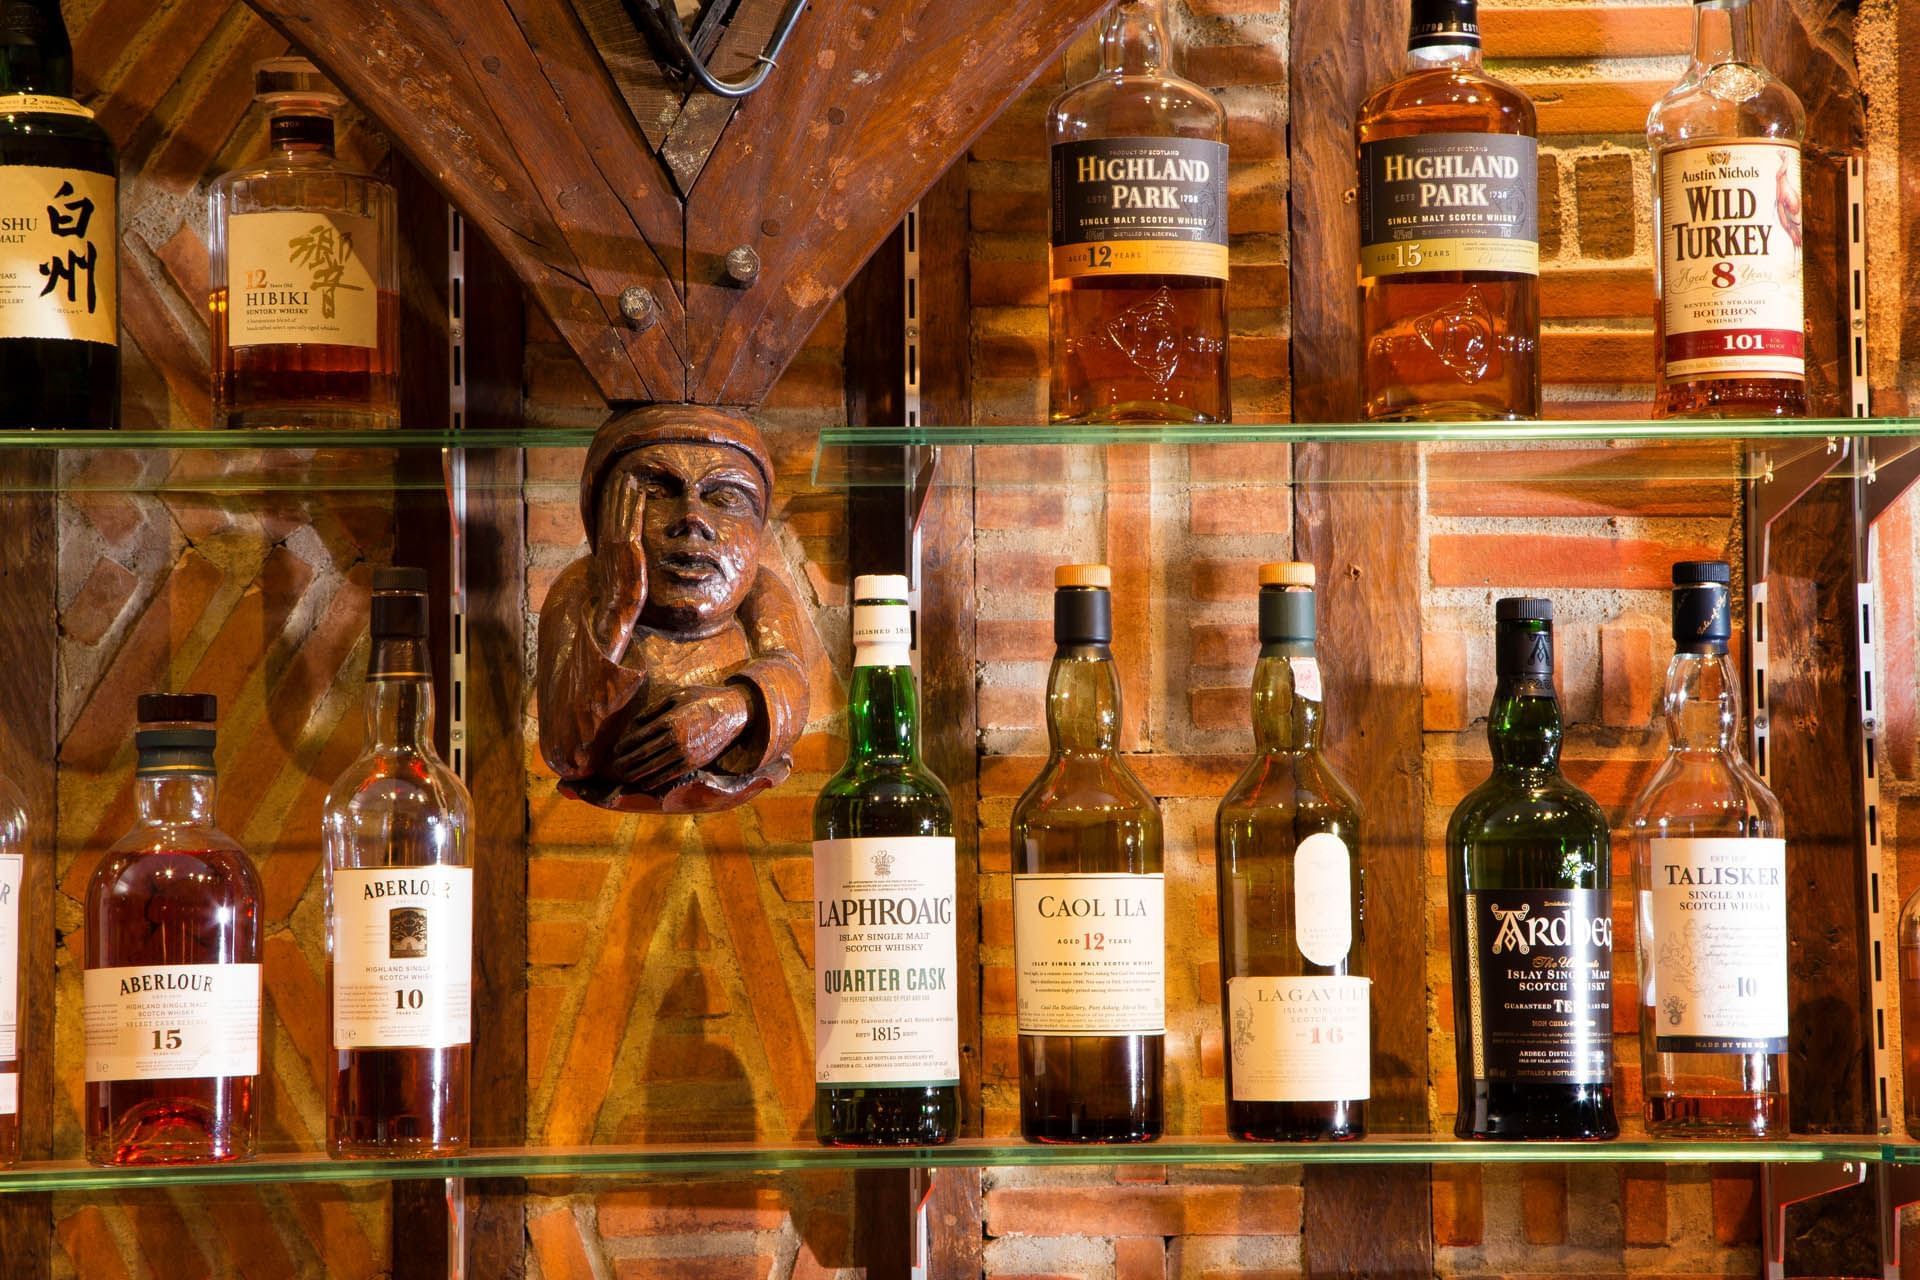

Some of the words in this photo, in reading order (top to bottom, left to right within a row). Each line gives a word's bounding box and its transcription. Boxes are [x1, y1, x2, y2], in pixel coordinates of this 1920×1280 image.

[23, 97, 39, 105] 12
[1077, 156, 1209, 182] HIGHLAND
[1384, 154, 1519, 182] HIGHLAND
[1681, 168, 1716, 183] Austin
[1719, 166, 1760, 180] Nichols
[1112, 185, 1180, 209] PARK
[1419, 183, 1489, 208] PARK
[1685, 186, 1757, 222] WILD
[1079, 216, 1109, 225] SINGLE
[1113, 216, 1136, 224] MALT
[1140, 216, 1174, 224] SCOTCH
[1177, 217, 1208, 225] WHISKY
[1388, 215, 1417, 225] SINGLE
[1422, 214, 1444, 223] MALT
[1449, 213, 1483, 222] SCOTCH
[1487, 214, 1517, 222] WHISKY
[39, 181, 97, 314] 白州
[1672, 222, 1772, 261] TURKEY
[1087, 246, 1112, 267] 12
[1395, 244, 1422, 267] 15
[246, 269, 267, 290] 12
[1678, 267, 1708, 287] Aged
[1711, 262, 1736, 288] 8
[246, 292, 309, 306] HIBIKI
[1683, 300, 1724, 309] KENTUCKY
[246, 308, 277, 316] SUNTORY
[1693, 307, 1757, 318] BOURBON
[1706, 317, 1743, 325] WHISKEY
[1723, 334, 1765, 350] 101
[1664, 865, 1779, 885] TALISKER
[364, 879, 452, 900] ABERLO
[1688, 890, 1733, 899] SINGLE
[819, 897, 951, 927] LAPHROAIG
[1038, 895, 1105, 918] CAOL
[1114, 898, 1147, 917] ILA
[1679, 901, 1726, 911] SCOTCH
[839, 934, 864, 942] ISLAY
[867, 933, 903, 941] SINGLE
[906, 932, 930, 940] MALT
[1083, 932, 1104, 951] 12
[845, 944, 882, 953] SCOTCH
[886, 943, 924, 952] WHISKY
[366, 965, 404, 973] HIGHLAND
[1507, 969, 1544, 979] ISLAY
[119, 973, 213, 996] ABERLOUR
[379, 974, 409, 982] SCOTCH
[824, 968, 900, 994] QUARTER
[906, 967, 946, 990] CASK
[1519, 982, 1567, 991] SCOTCH
[1737, 976, 1757, 997] 10
[126, 1002, 161, 1010] HIGHLAND
[395, 989, 423, 1009] 10
[1554, 999, 1580, 1013] TE
[126, 1020, 153, 1028] SELECT
[152, 1029, 183, 1050] 15
[872, 1026, 901, 1041] 1815
[1311, 1027, 1344, 1045] 16
